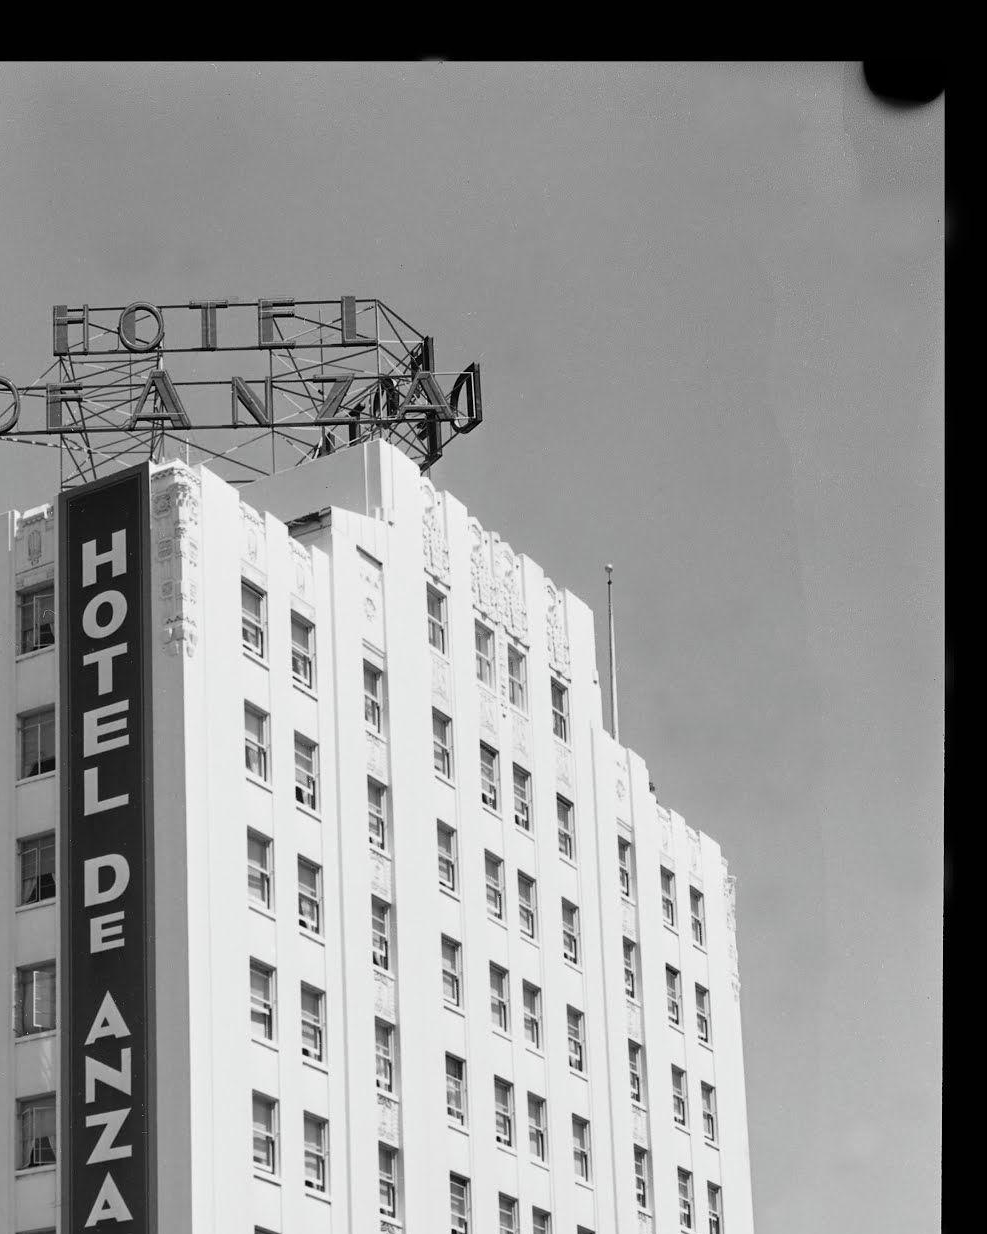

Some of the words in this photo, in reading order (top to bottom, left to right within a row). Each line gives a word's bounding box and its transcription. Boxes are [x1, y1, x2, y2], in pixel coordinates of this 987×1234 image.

[52, 296, 377, 355] HOTEL
[128, 370, 455, 430] ANZA
[81, 528, 130, 817] HOTEL
[83, 853, 131, 954] DE
[83, 989, 134, 1229] ANZA
